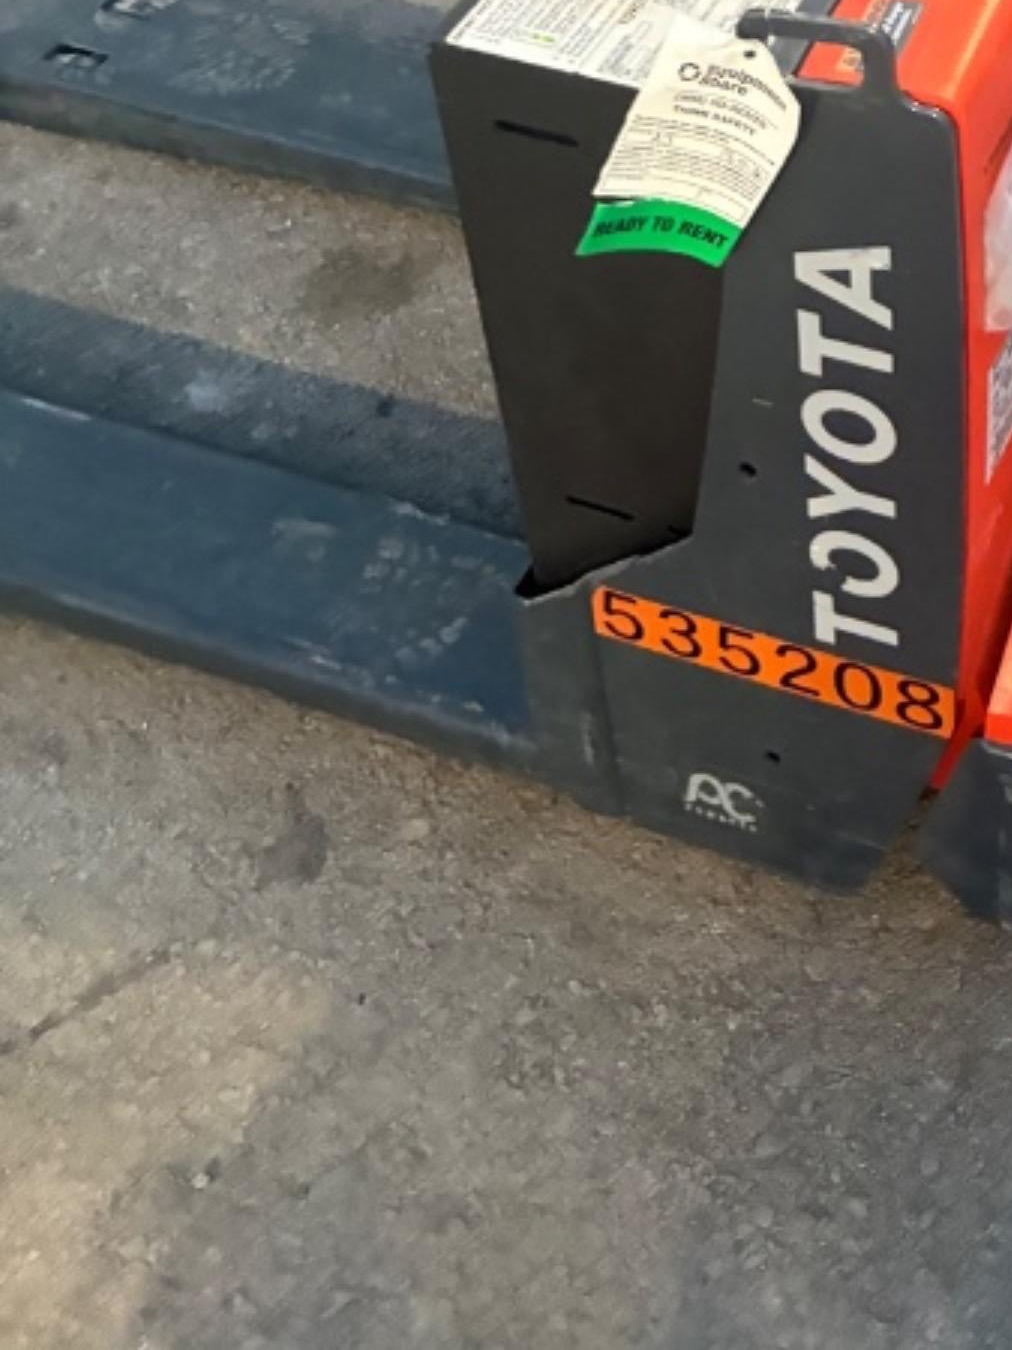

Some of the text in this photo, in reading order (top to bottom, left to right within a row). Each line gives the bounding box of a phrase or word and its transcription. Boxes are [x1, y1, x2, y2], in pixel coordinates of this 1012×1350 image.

[593, 214, 730, 248] READY TO RENT
[794, 246, 899, 647] TOYOTA
[600, 587, 945, 732] 535208
